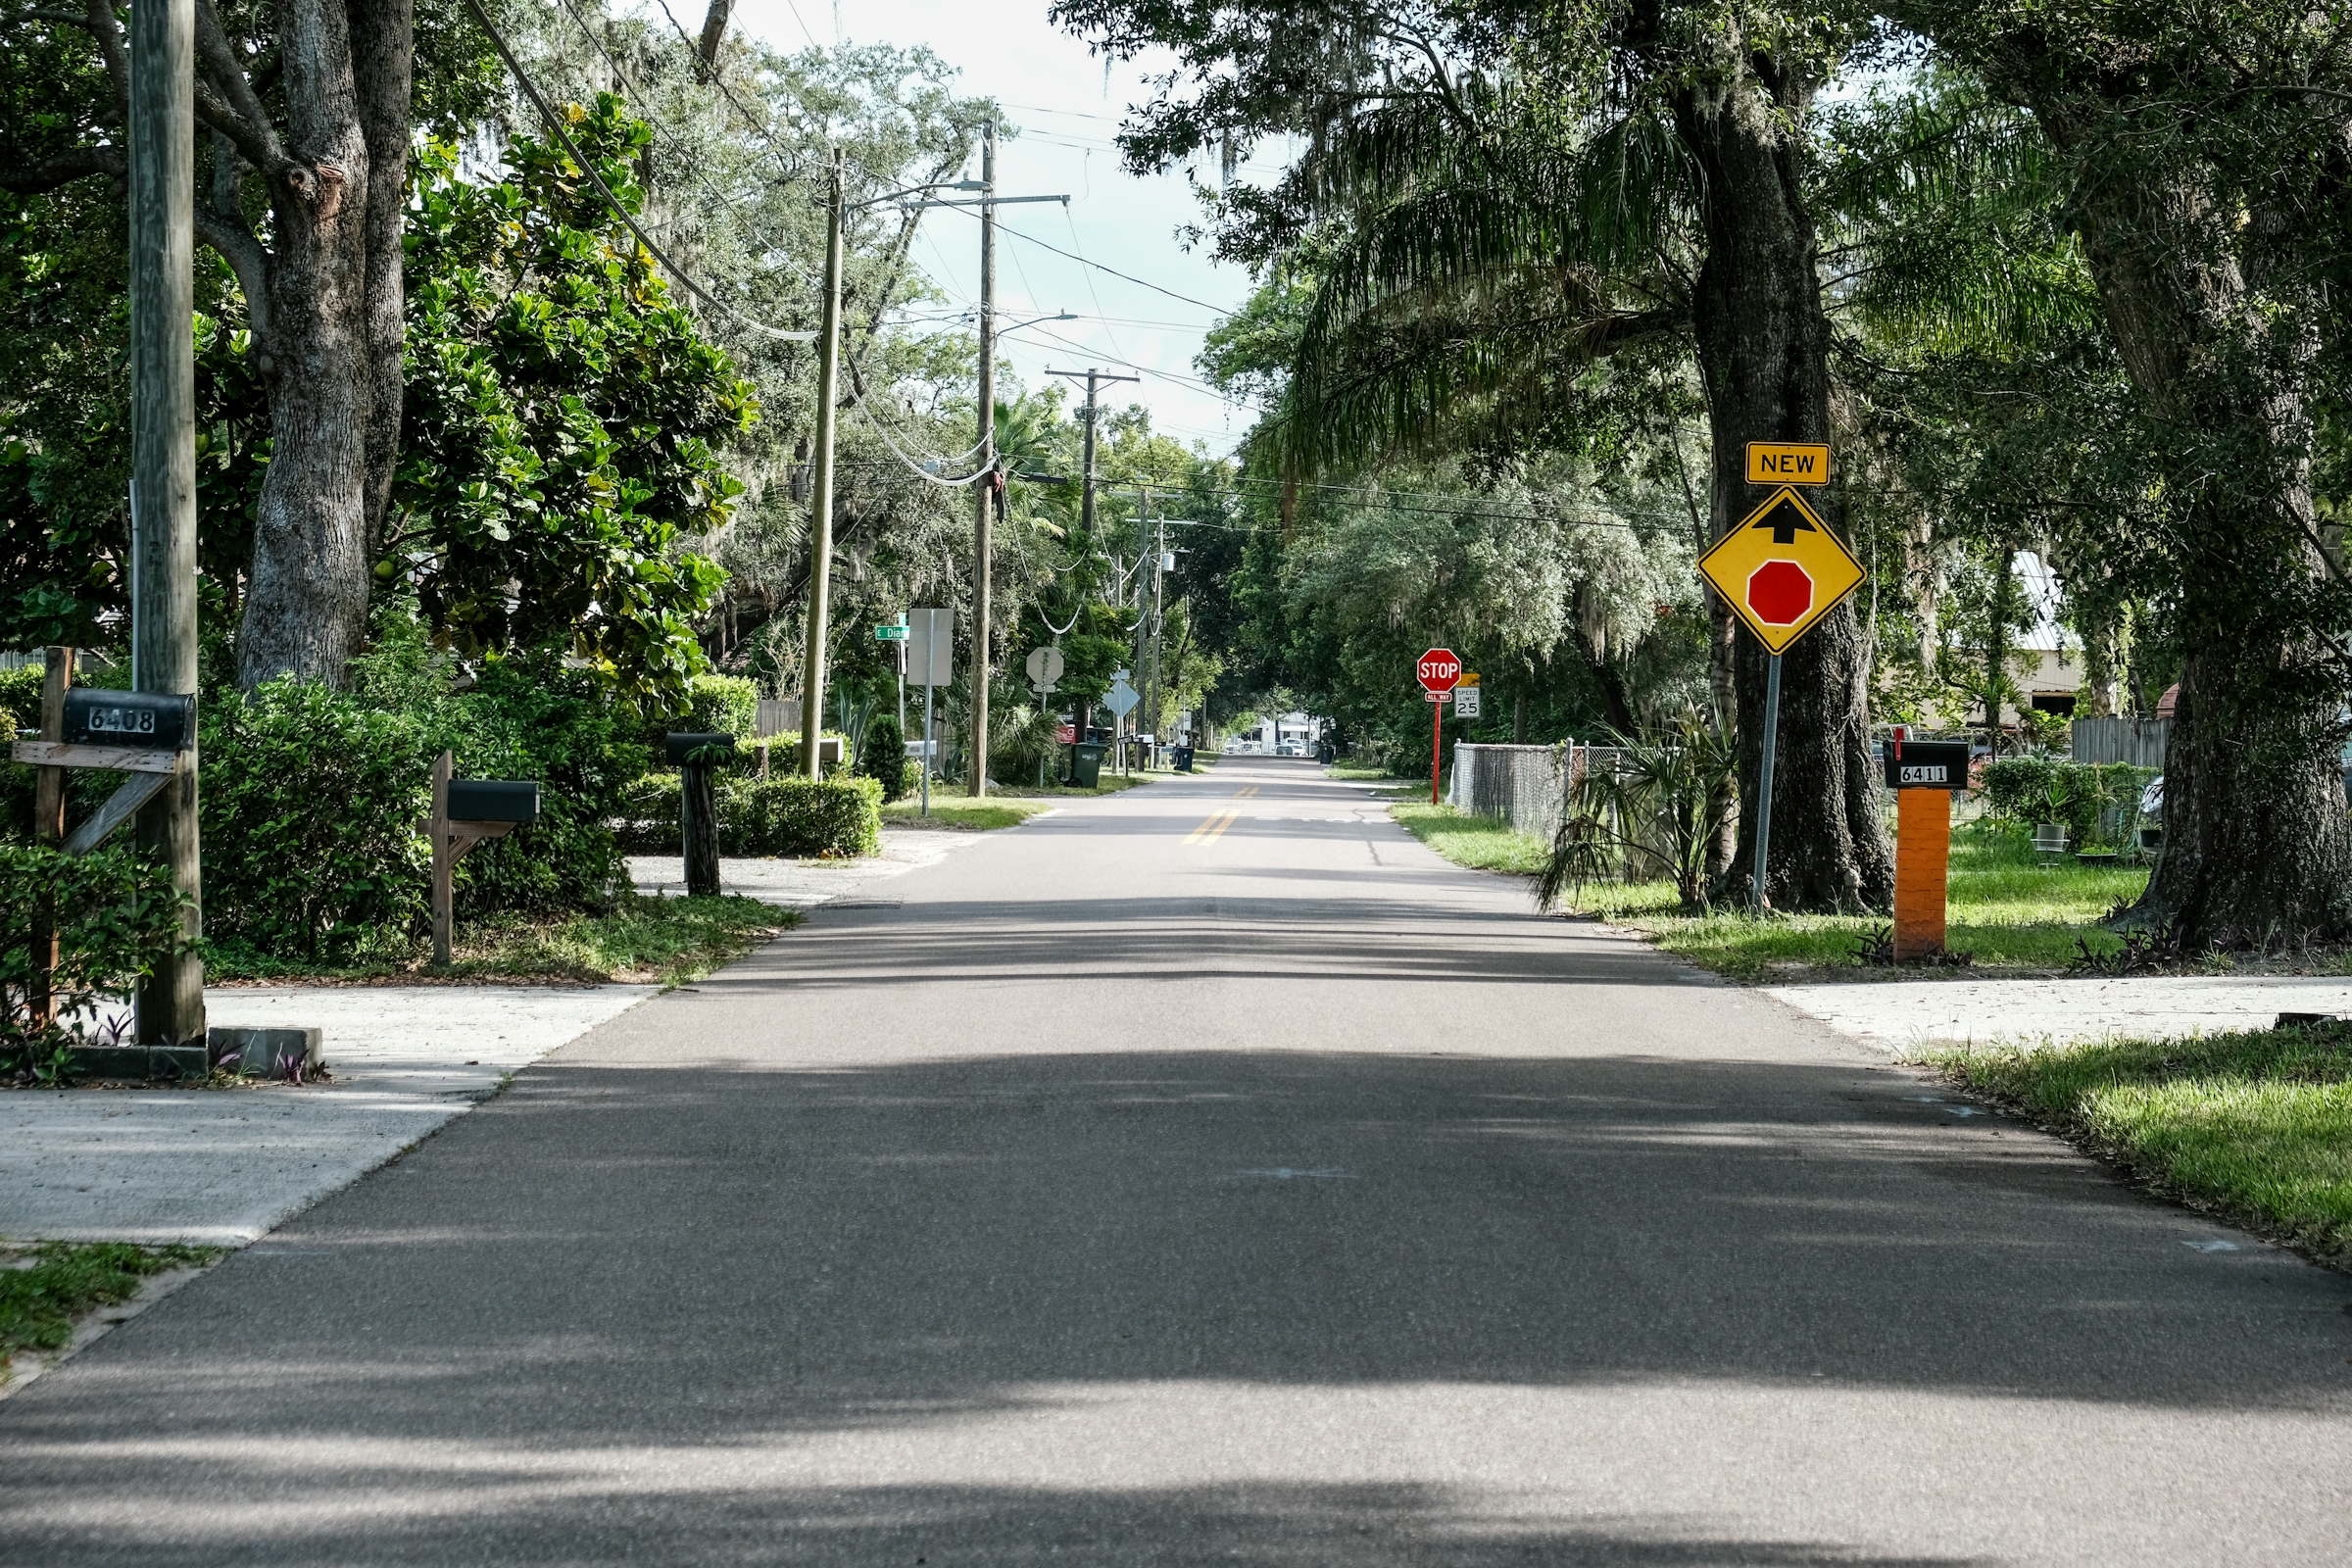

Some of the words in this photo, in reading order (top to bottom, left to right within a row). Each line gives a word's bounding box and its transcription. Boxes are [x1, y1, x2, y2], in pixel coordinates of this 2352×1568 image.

[1761, 454, 1815, 473] NEW
[1420, 662, 1458, 679] STOP
[1457, 703, 1478, 714] 25
[91, 708, 153, 733] 6408
[1902, 766, 1945, 782] 6411
